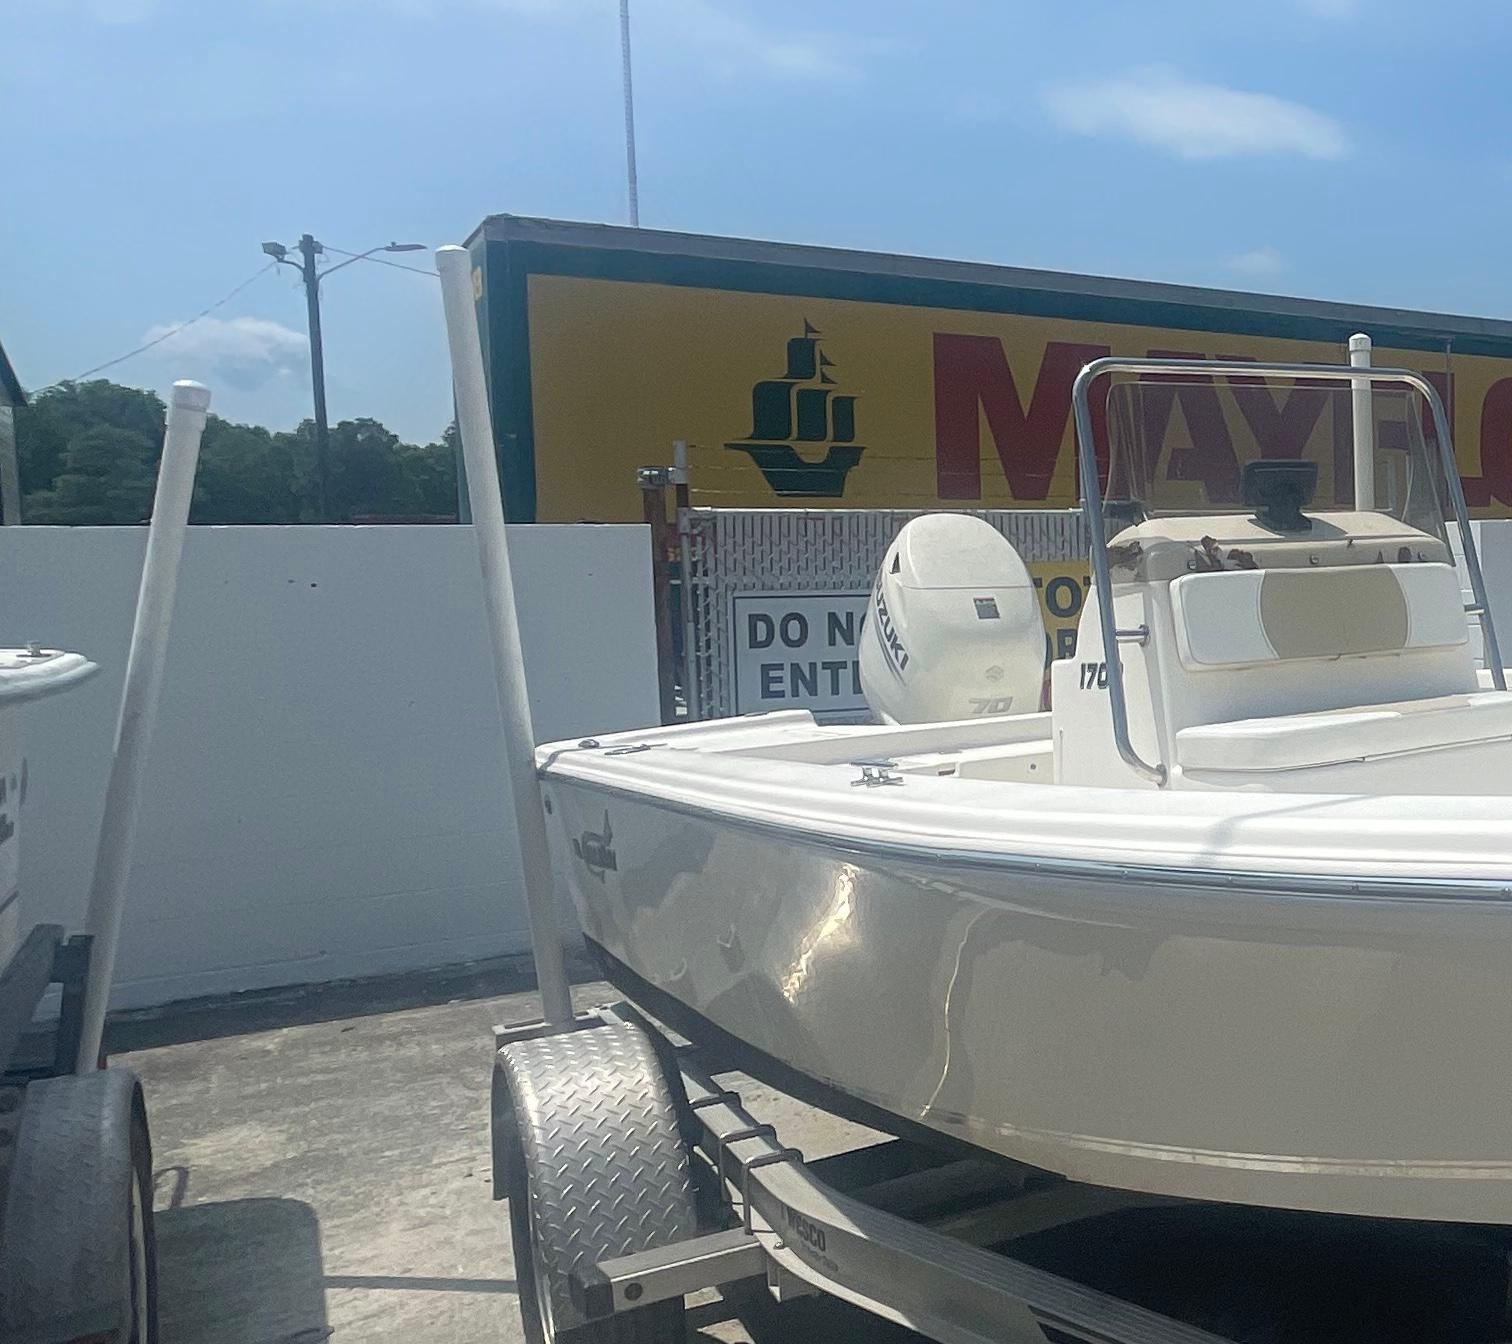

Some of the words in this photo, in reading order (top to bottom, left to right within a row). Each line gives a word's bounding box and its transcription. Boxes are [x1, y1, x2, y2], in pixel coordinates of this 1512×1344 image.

[748, 612, 809, 649] DO
[760, 659, 864, 699] ENT
[969, 696, 1013, 714] 70
